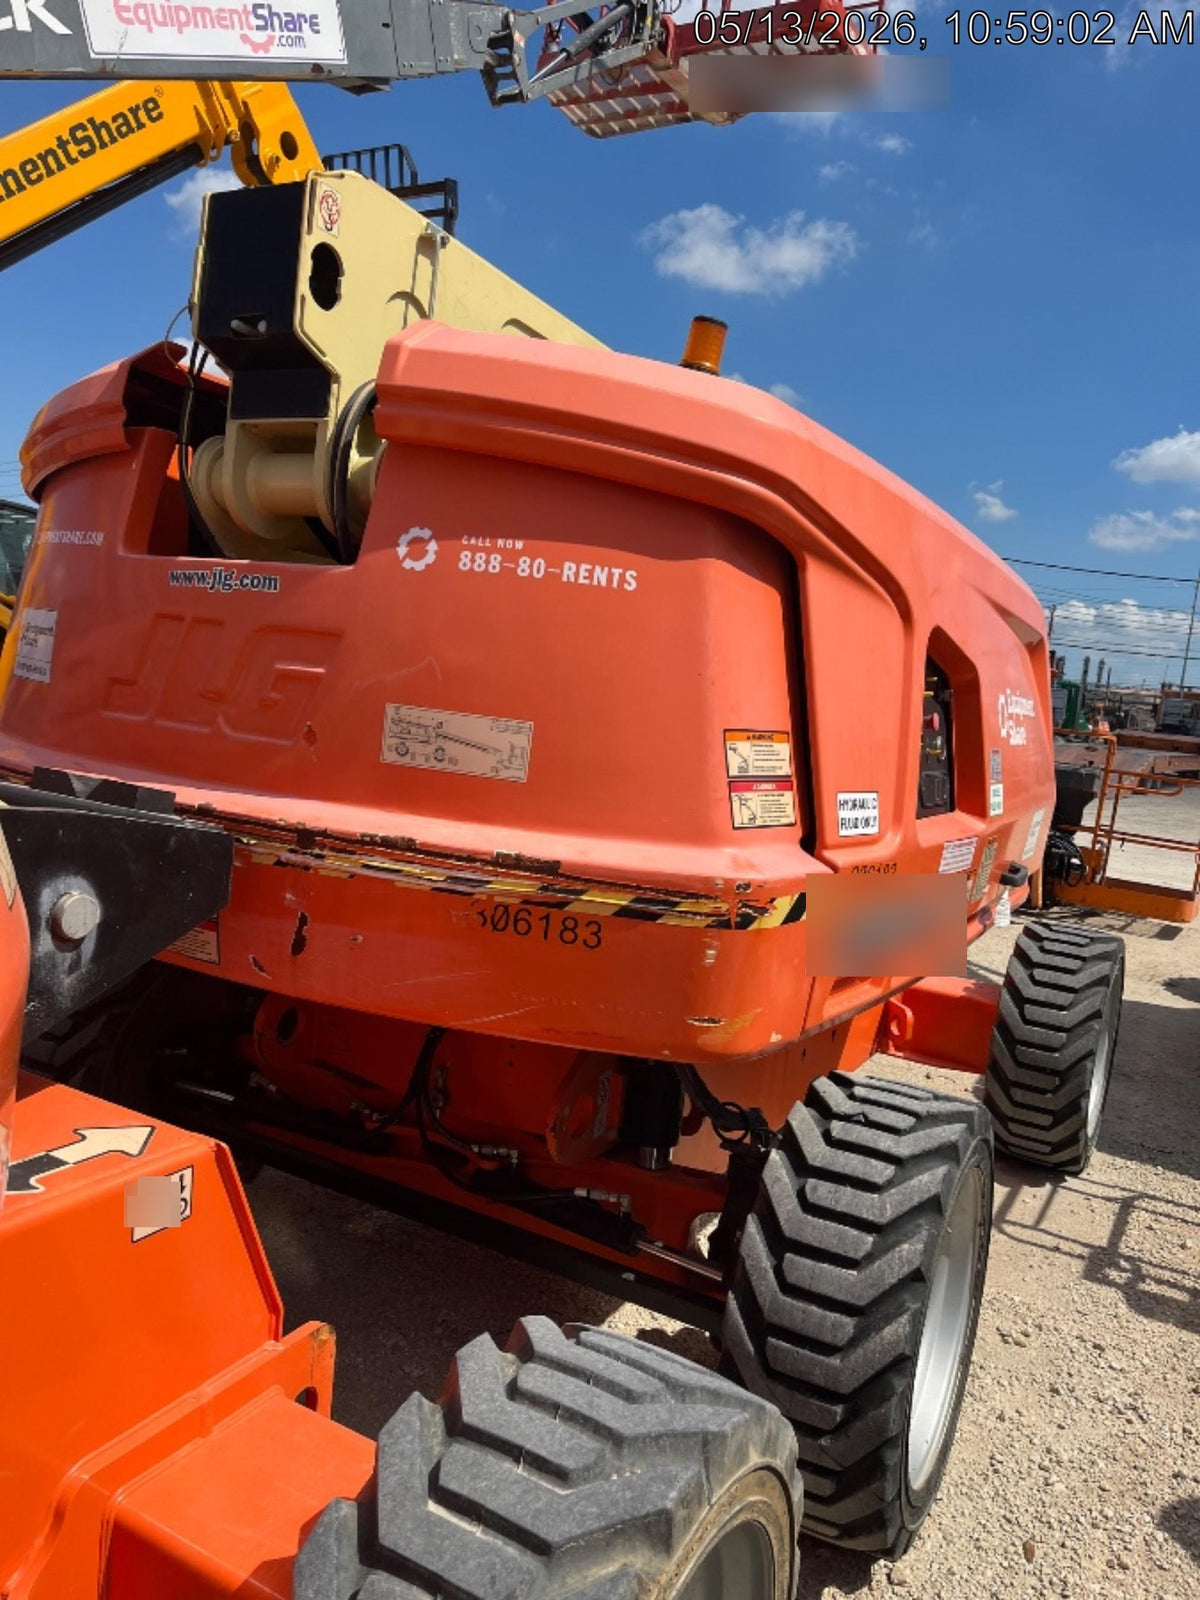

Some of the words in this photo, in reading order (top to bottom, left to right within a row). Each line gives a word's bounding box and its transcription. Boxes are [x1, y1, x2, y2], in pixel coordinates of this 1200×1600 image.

[461, 534, 491, 547] CALL
[497, 538, 524, 550] NOW
[169, 566, 279, 592] www.jlg.com
[458, 550, 638, 591] 888-80-RENTS
[101, 612, 345, 745] JLG
